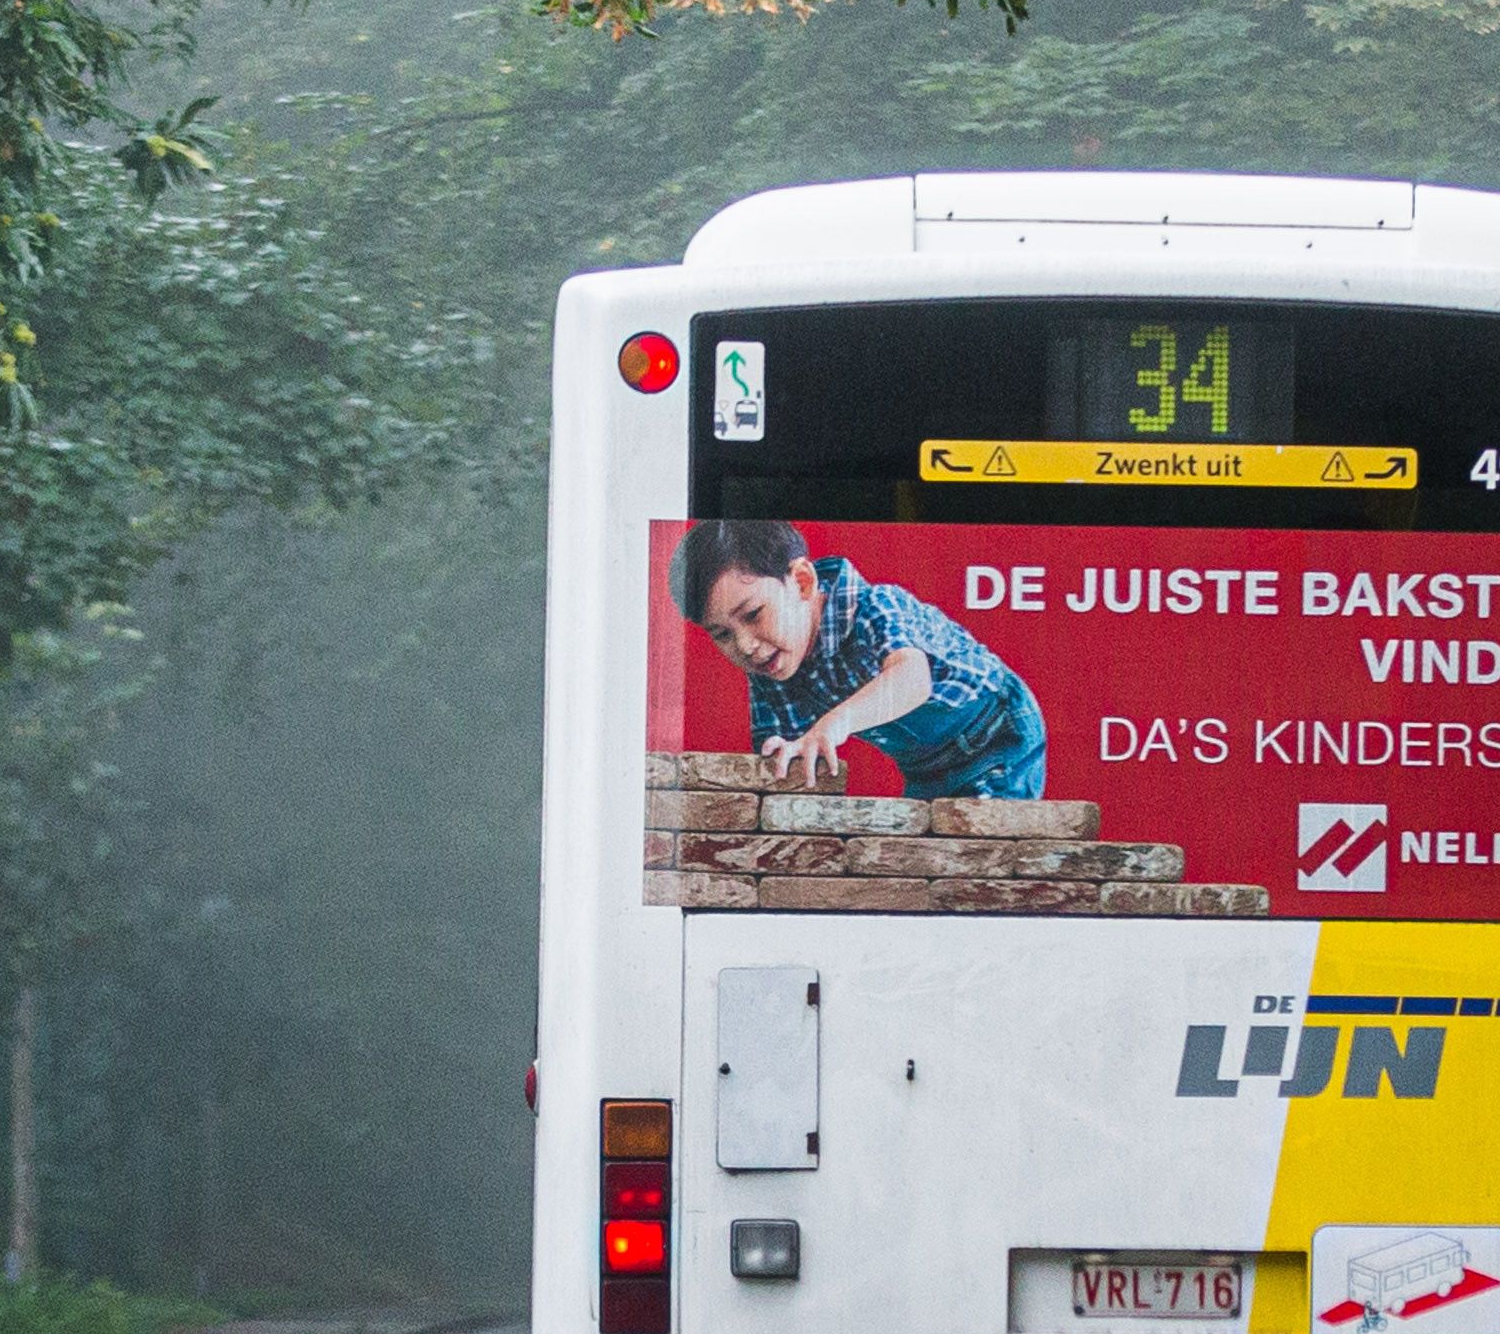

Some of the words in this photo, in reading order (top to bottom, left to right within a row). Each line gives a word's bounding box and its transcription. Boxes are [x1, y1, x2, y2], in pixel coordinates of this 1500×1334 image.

[1129, 324, 1230, 434] 34
[1095, 450, 1199, 477] Zwenkt
[1206, 453, 1242, 478] uit
[964, 565, 1046, 612] DE
[1065, 568, 1280, 616] JUISTE
[1099, 716, 1230, 765] DA'S
[1252, 994, 1297, 1014] DE
[1175, 1024, 1448, 1100] LIJN
